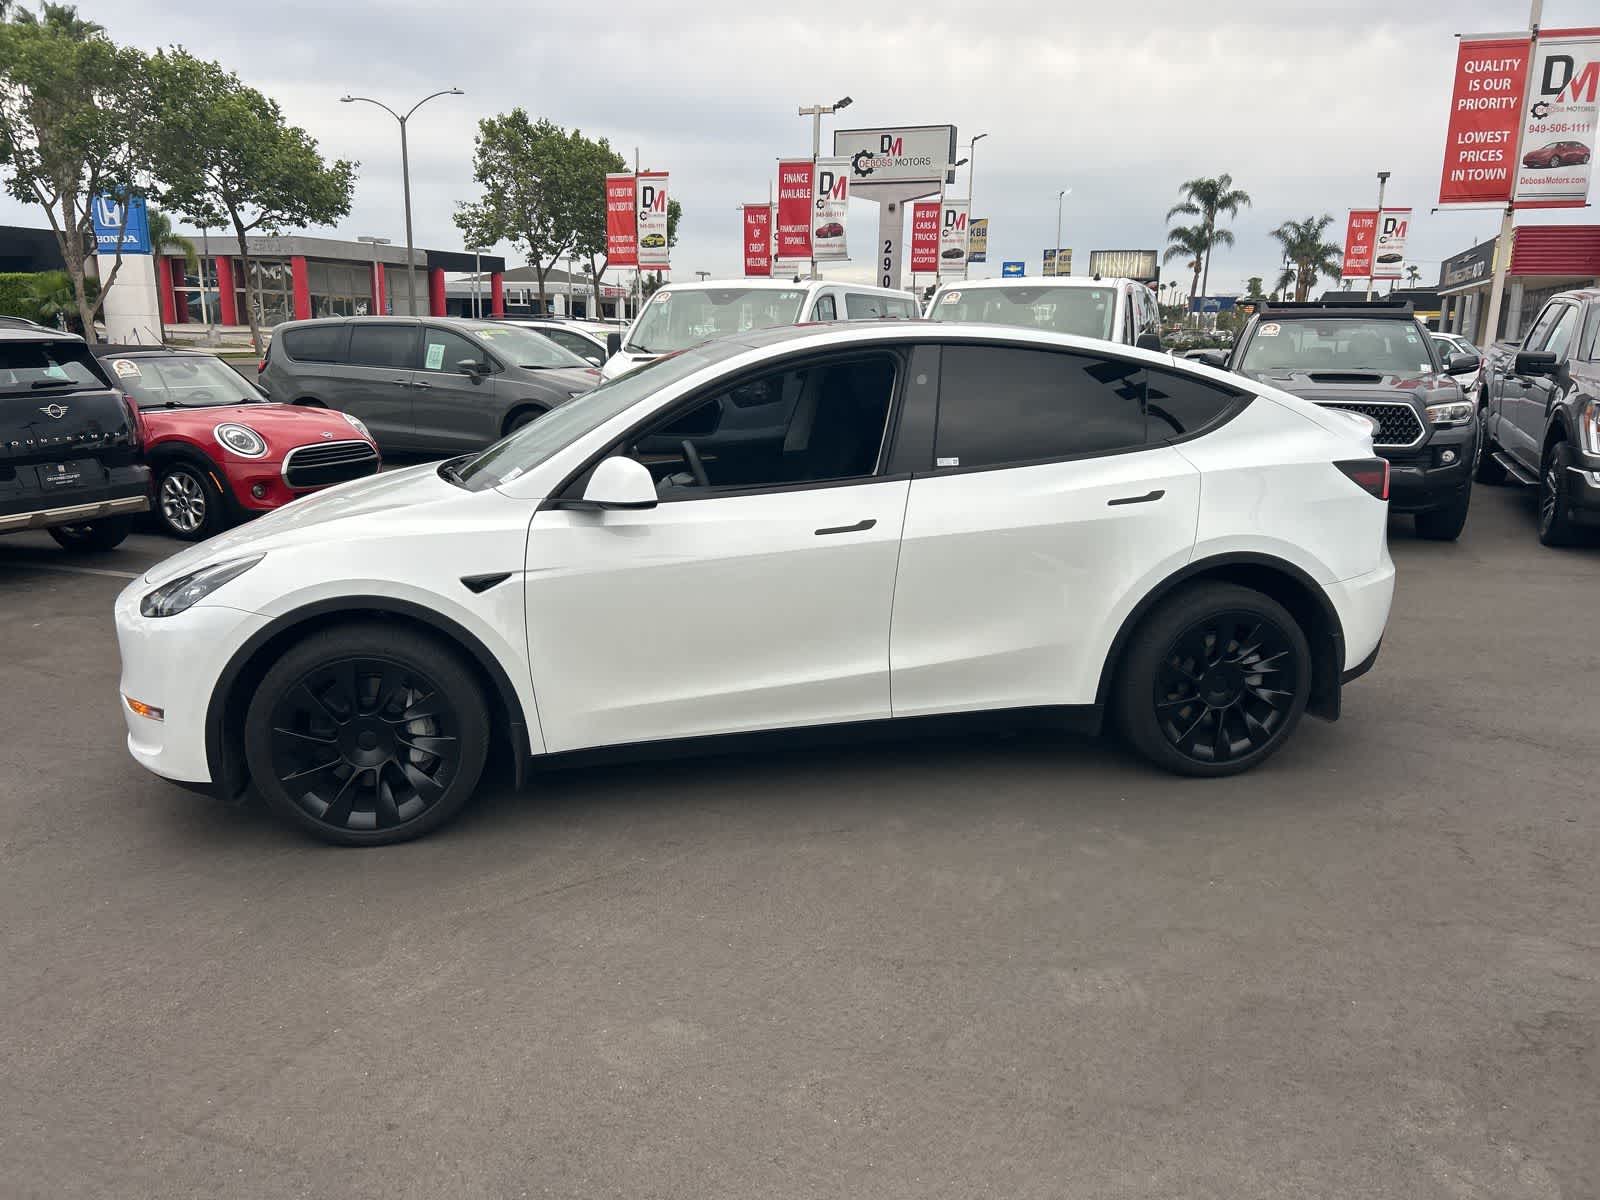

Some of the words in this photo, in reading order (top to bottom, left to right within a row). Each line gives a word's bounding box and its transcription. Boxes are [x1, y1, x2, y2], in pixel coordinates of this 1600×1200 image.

[1464, 58, 1521, 73] QUALITY
[1468, 79, 1480, 91] IS
[1483, 78, 1512, 91] OUR
[1541, 55, 1600, 103] DM
[1457, 96, 1518, 111] PRIORITY
[1528, 123, 1591, 134] 949-506-1111
[1457, 130, 1511, 145] LOWEST
[880, 134, 903, 157] DM
[859, 157, 893, 168] DEBOSS
[894, 156, 931, 166] MOTORS
[1459, 149, 1504, 163] PRICES
[783, 172, 809, 183] FINANCE
[1450, 169, 1465, 182] IN
[1467, 167, 1507, 181] TOWN
[819, 171, 848, 201] DM
[642, 185, 666, 213] DM
[780, 188, 811, 199] AVAILABLE
[915, 210, 925, 218] WE
[926, 210, 938, 218] BUY
[945, 209, 967, 231] DM
[915, 221, 931, 230] CARS
[970, 227, 987, 237] KBB
[1383, 217, 1408, 238] DM
[914, 232, 937, 241] TRUCKS
[912, 256, 937, 264] ACCEPTED
